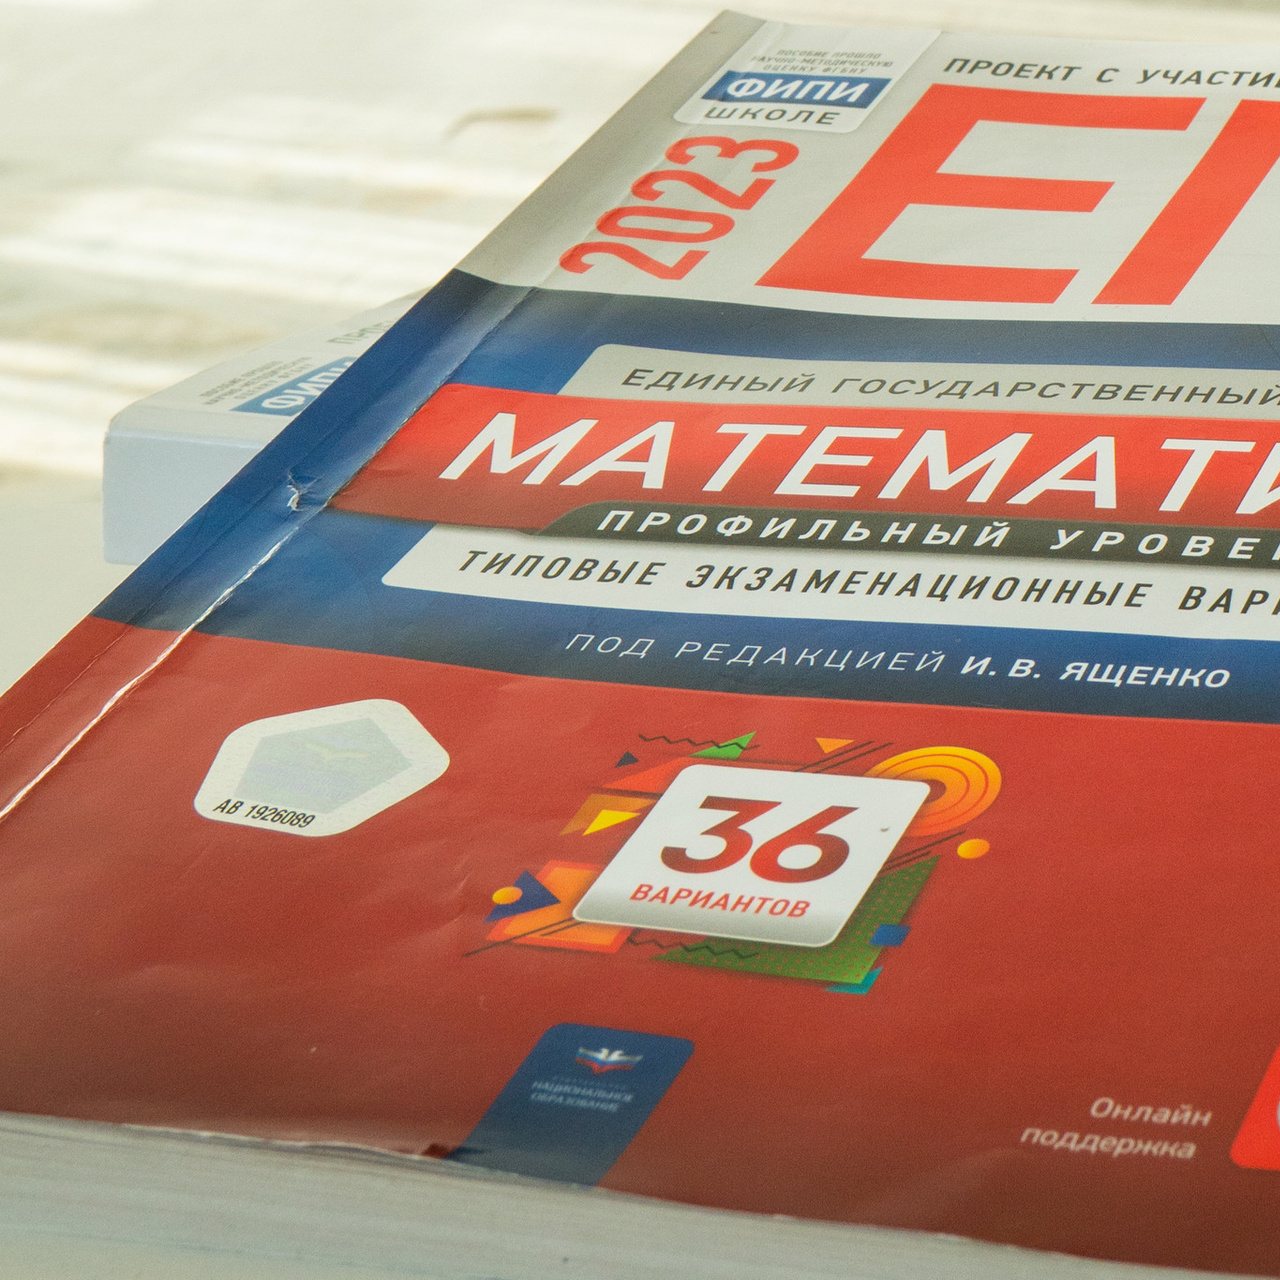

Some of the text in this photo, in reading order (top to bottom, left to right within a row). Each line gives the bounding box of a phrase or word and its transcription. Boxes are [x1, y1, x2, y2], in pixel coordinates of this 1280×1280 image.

[943, 57, 1082, 83] ПРОЕКТ
[1096, 67, 1121, 83] С
[727, 77, 870, 103] ФИПИ
[703, 106, 841, 125] ШКОЛЕ
[558, 134, 801, 282] 2023
[621, 367, 824, 396] ЕДИНЫЙ
[596, 509, 1013, 550] ПРОФИЛЬНЫЙ
[458, 549, 667, 587] ТИПОВЫЕ
[684, 564, 1154, 608] ЭКЗАМЕНАЦИОННЫЕ
[564, 632, 1231, 689] ПОД РЕДАКЦИЕЙ И. В. ЯЩЕНКО
[244, 804, 316, 828] 1926089
[660, 794, 861, 885] 36
[629, 883, 812, 919] ВАРИАНТОВ
[1089, 1096, 1213, 1127] Онлайн
[1019, 1127, 1198, 1159] поддержка
